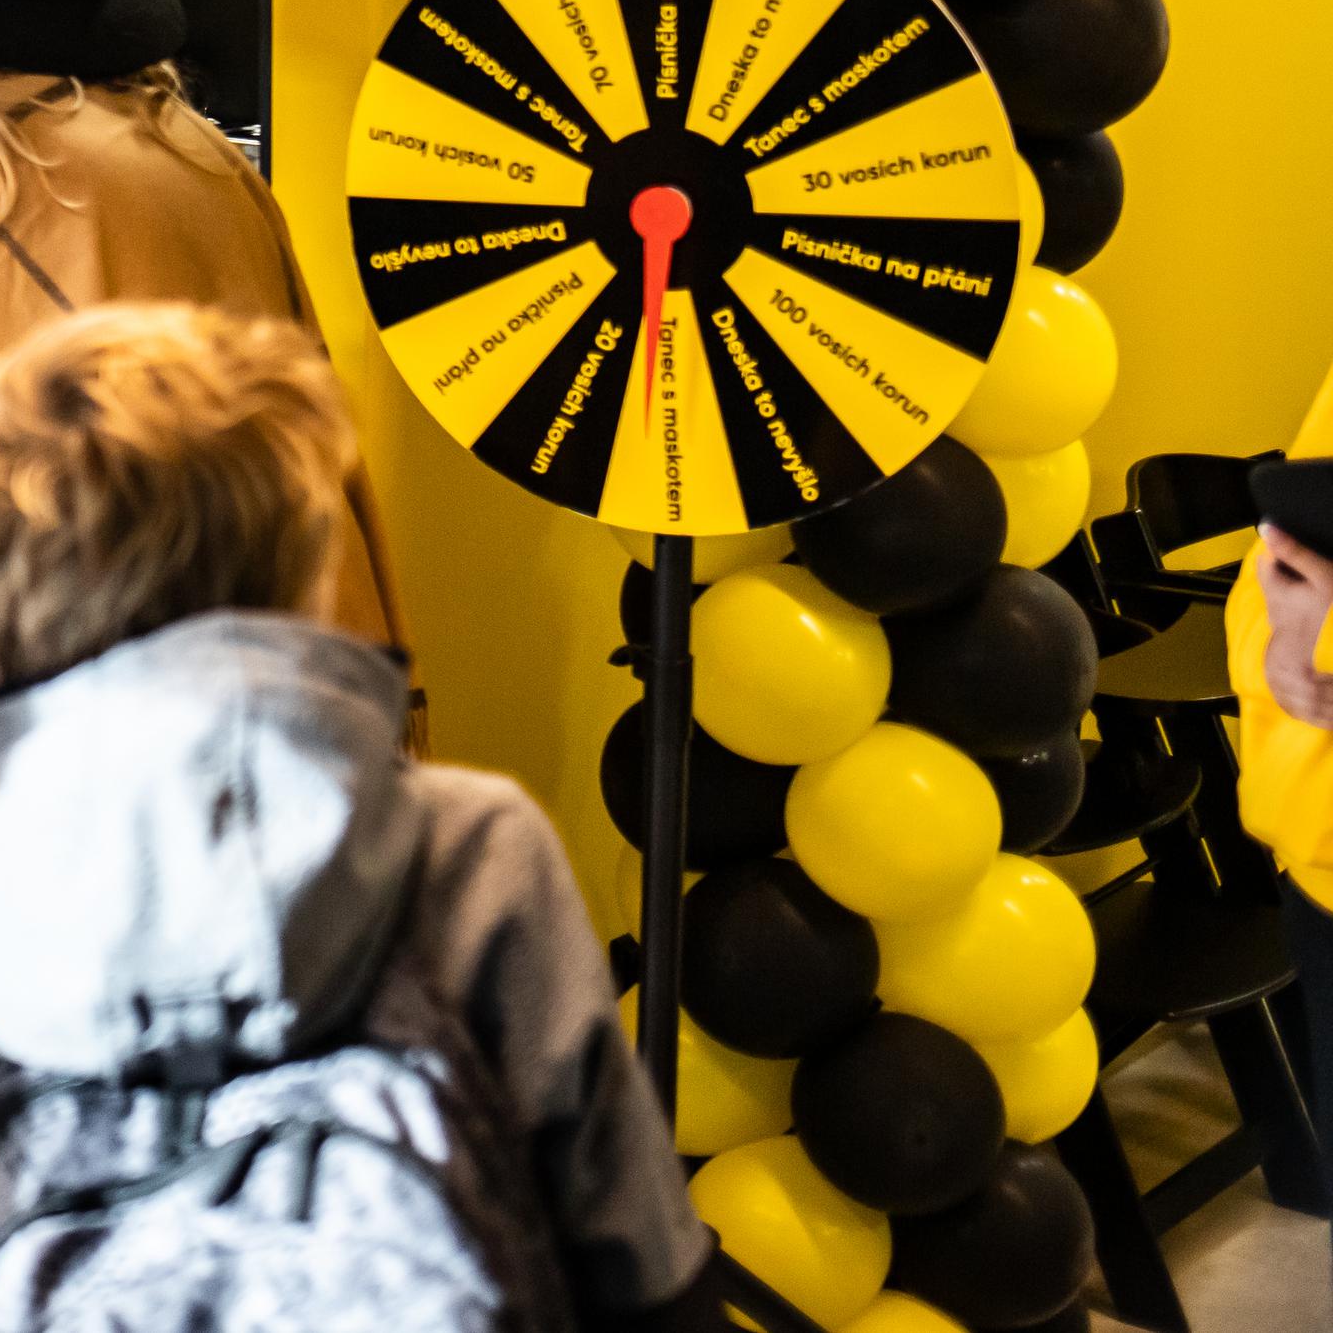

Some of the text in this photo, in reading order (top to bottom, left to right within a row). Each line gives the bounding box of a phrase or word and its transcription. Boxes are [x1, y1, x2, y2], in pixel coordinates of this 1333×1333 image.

[418, 7, 588, 153] Tanec s maskotem
[589, 66, 613, 93] 70
[656, 5, 679, 98] Písnička
[708, 44, 759, 122] Dneska
[750, 18, 771, 39] to
[743, 18, 930, 157] Tanec s maskotem
[369, 127, 536, 183] 50 vosích korun
[801, 145, 991, 192] 30 vosích korun
[370, 220, 567, 272] Dneska to nevyšlo
[781, 229, 993, 297] Písnička na přání
[433, 271, 583, 395] Písnička na přání
[769, 289, 930, 425] 100 vosích korun
[531, 318, 623, 474] 20 vosích korun
[658, 318, 684, 522] Tanec s maskotem
[711, 308, 819, 502] Dneska to nevyšlo
